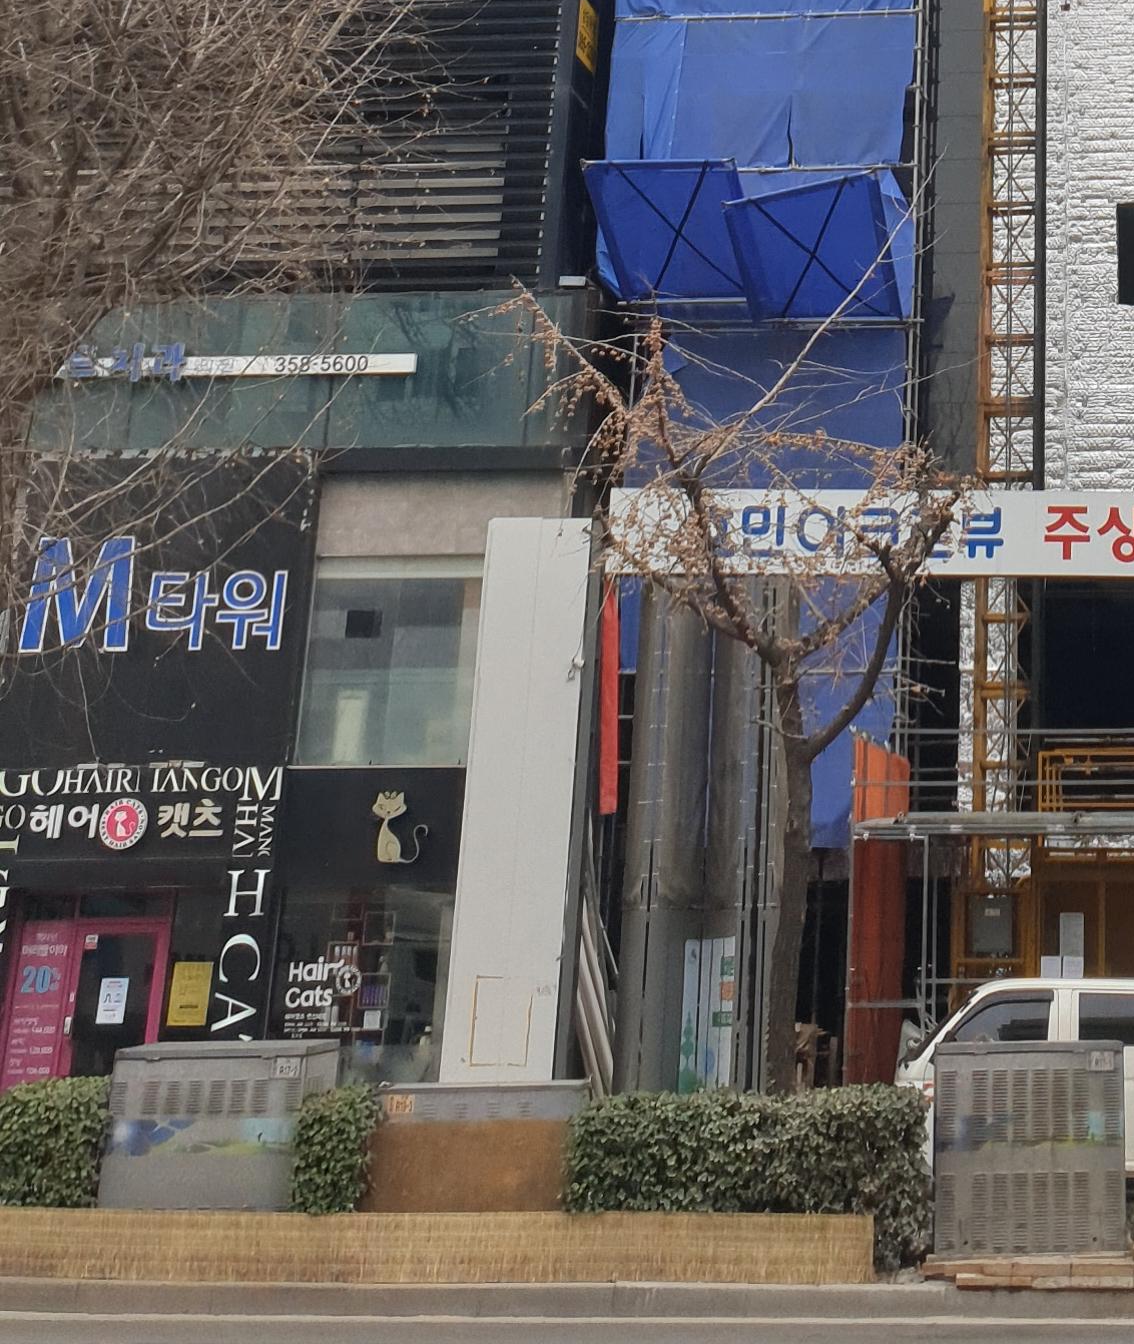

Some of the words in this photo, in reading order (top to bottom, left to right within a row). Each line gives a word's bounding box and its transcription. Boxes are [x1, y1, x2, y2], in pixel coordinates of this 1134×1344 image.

[274, 355, 369, 373] 358-5600
[708, 505, 1005, 560] 민아크뷰
[29, 802, 100, 840] 헤어
[156, 798, 224, 838] 캣츠
[288, 956, 345, 983] Hair
[285, 985, 333, 1008] Cats
